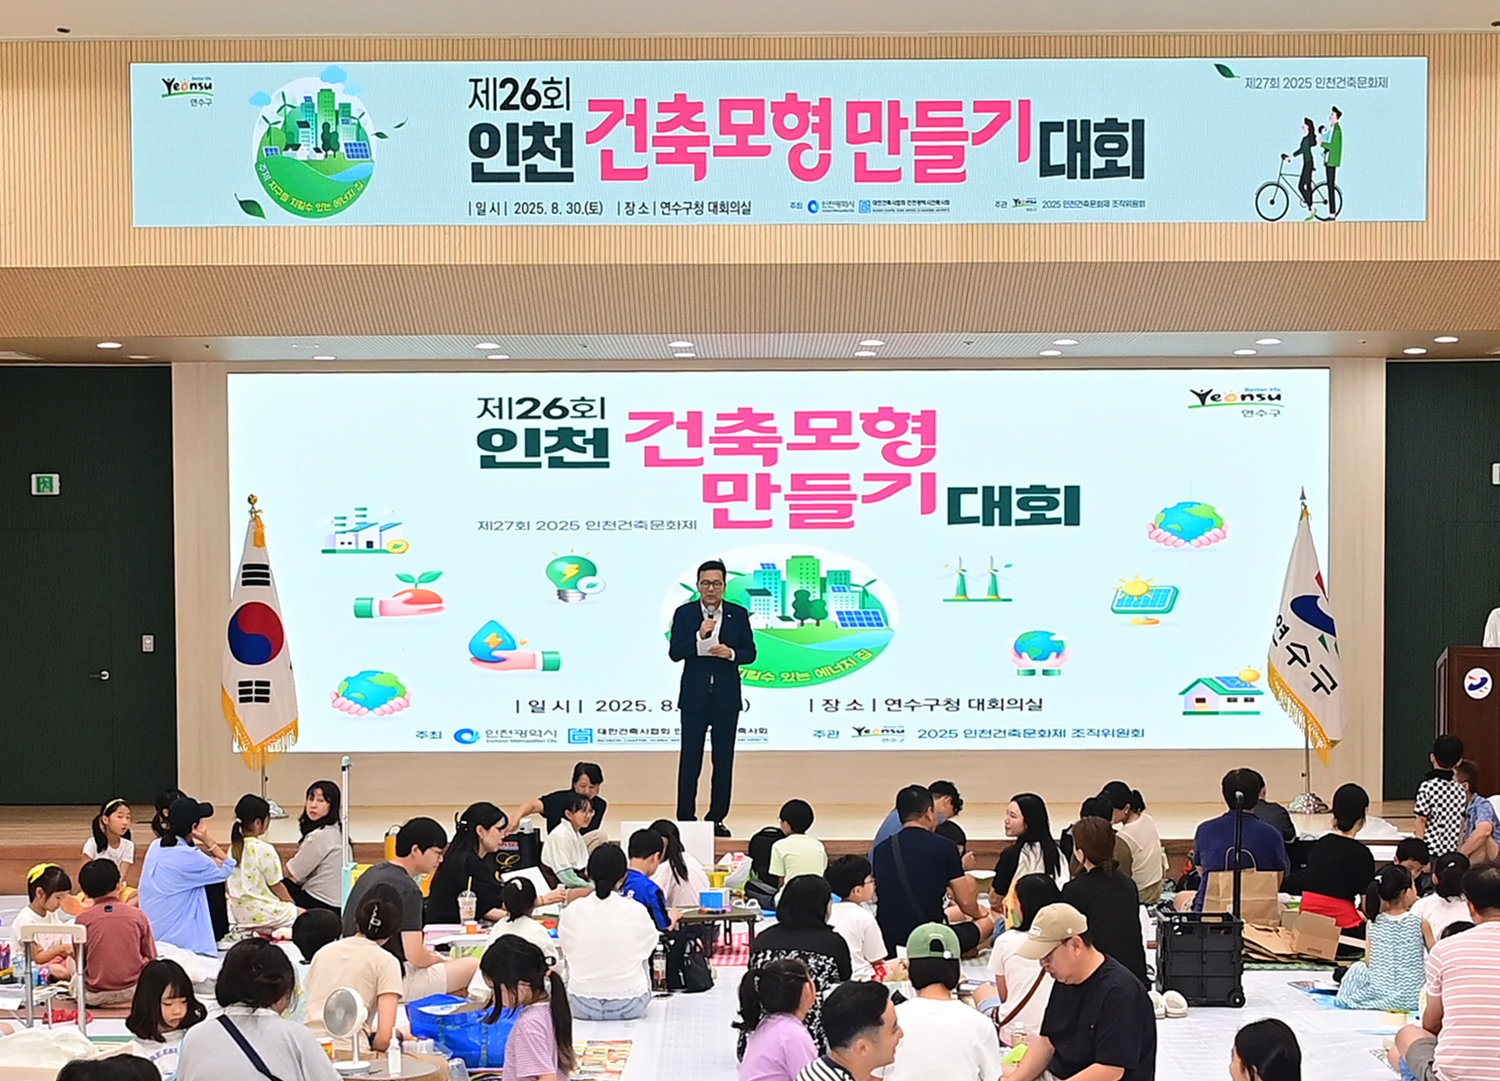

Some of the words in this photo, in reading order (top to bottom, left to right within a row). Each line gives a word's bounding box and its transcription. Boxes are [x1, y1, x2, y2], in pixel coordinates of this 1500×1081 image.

[161, 77, 212, 95] Yeonsu
[1244, 76, 1280, 89] 제27회
[1283, 77, 1313, 89] 2025
[1315, 76, 1389, 89] 인천건축문화제
[467, 76, 572, 112] 제26회
[468, 121, 574, 183] 인천
[585, 92, 832, 184] 건축모형
[844, 97, 1032, 184] 만들기
[1038, 117, 1146, 180] 대회
[514, 202, 547, 215] 2025.
[551, 202, 562, 215] 8.
[565, 201, 604, 215] 30.(토)
[660, 201, 705, 216] 연수구청
[707, 201, 752, 216] 대회의실
[1042, 200, 1062, 209] 2025
[1189, 388, 1282, 406] Yeonsu
[476, 396, 605, 421] 제26회
[1241, 409, 1282, 418] 연수구
[476, 426, 611, 470] 인천
[625, 405, 938, 468] 건축모형
[701, 472, 938, 531] 만들기
[946, 484, 1081, 527] 대회
[477, 519, 531, 532] 제27회
[535, 520, 580, 531] 2025
[585, 519, 697, 533] 인천건축문화제
[780, 671, 811, 682] 있는
[814, 657, 858, 678] 에너지
[595, 699, 653, 713] 2025.
[884, 698, 961, 712] 연수구청
[967, 698, 1044, 712] 대회의실
[415, 730, 442, 740] 주최
[485, 729, 558, 739] 인천광역시
[597, 727, 670, 736] 대한건축사협회
[813, 729, 840, 739] 주관
[917, 729, 959, 740] 2025
[963, 729, 1067, 739] 인천건축문화제
[1071, 728, 1145, 740] 조직위원회
